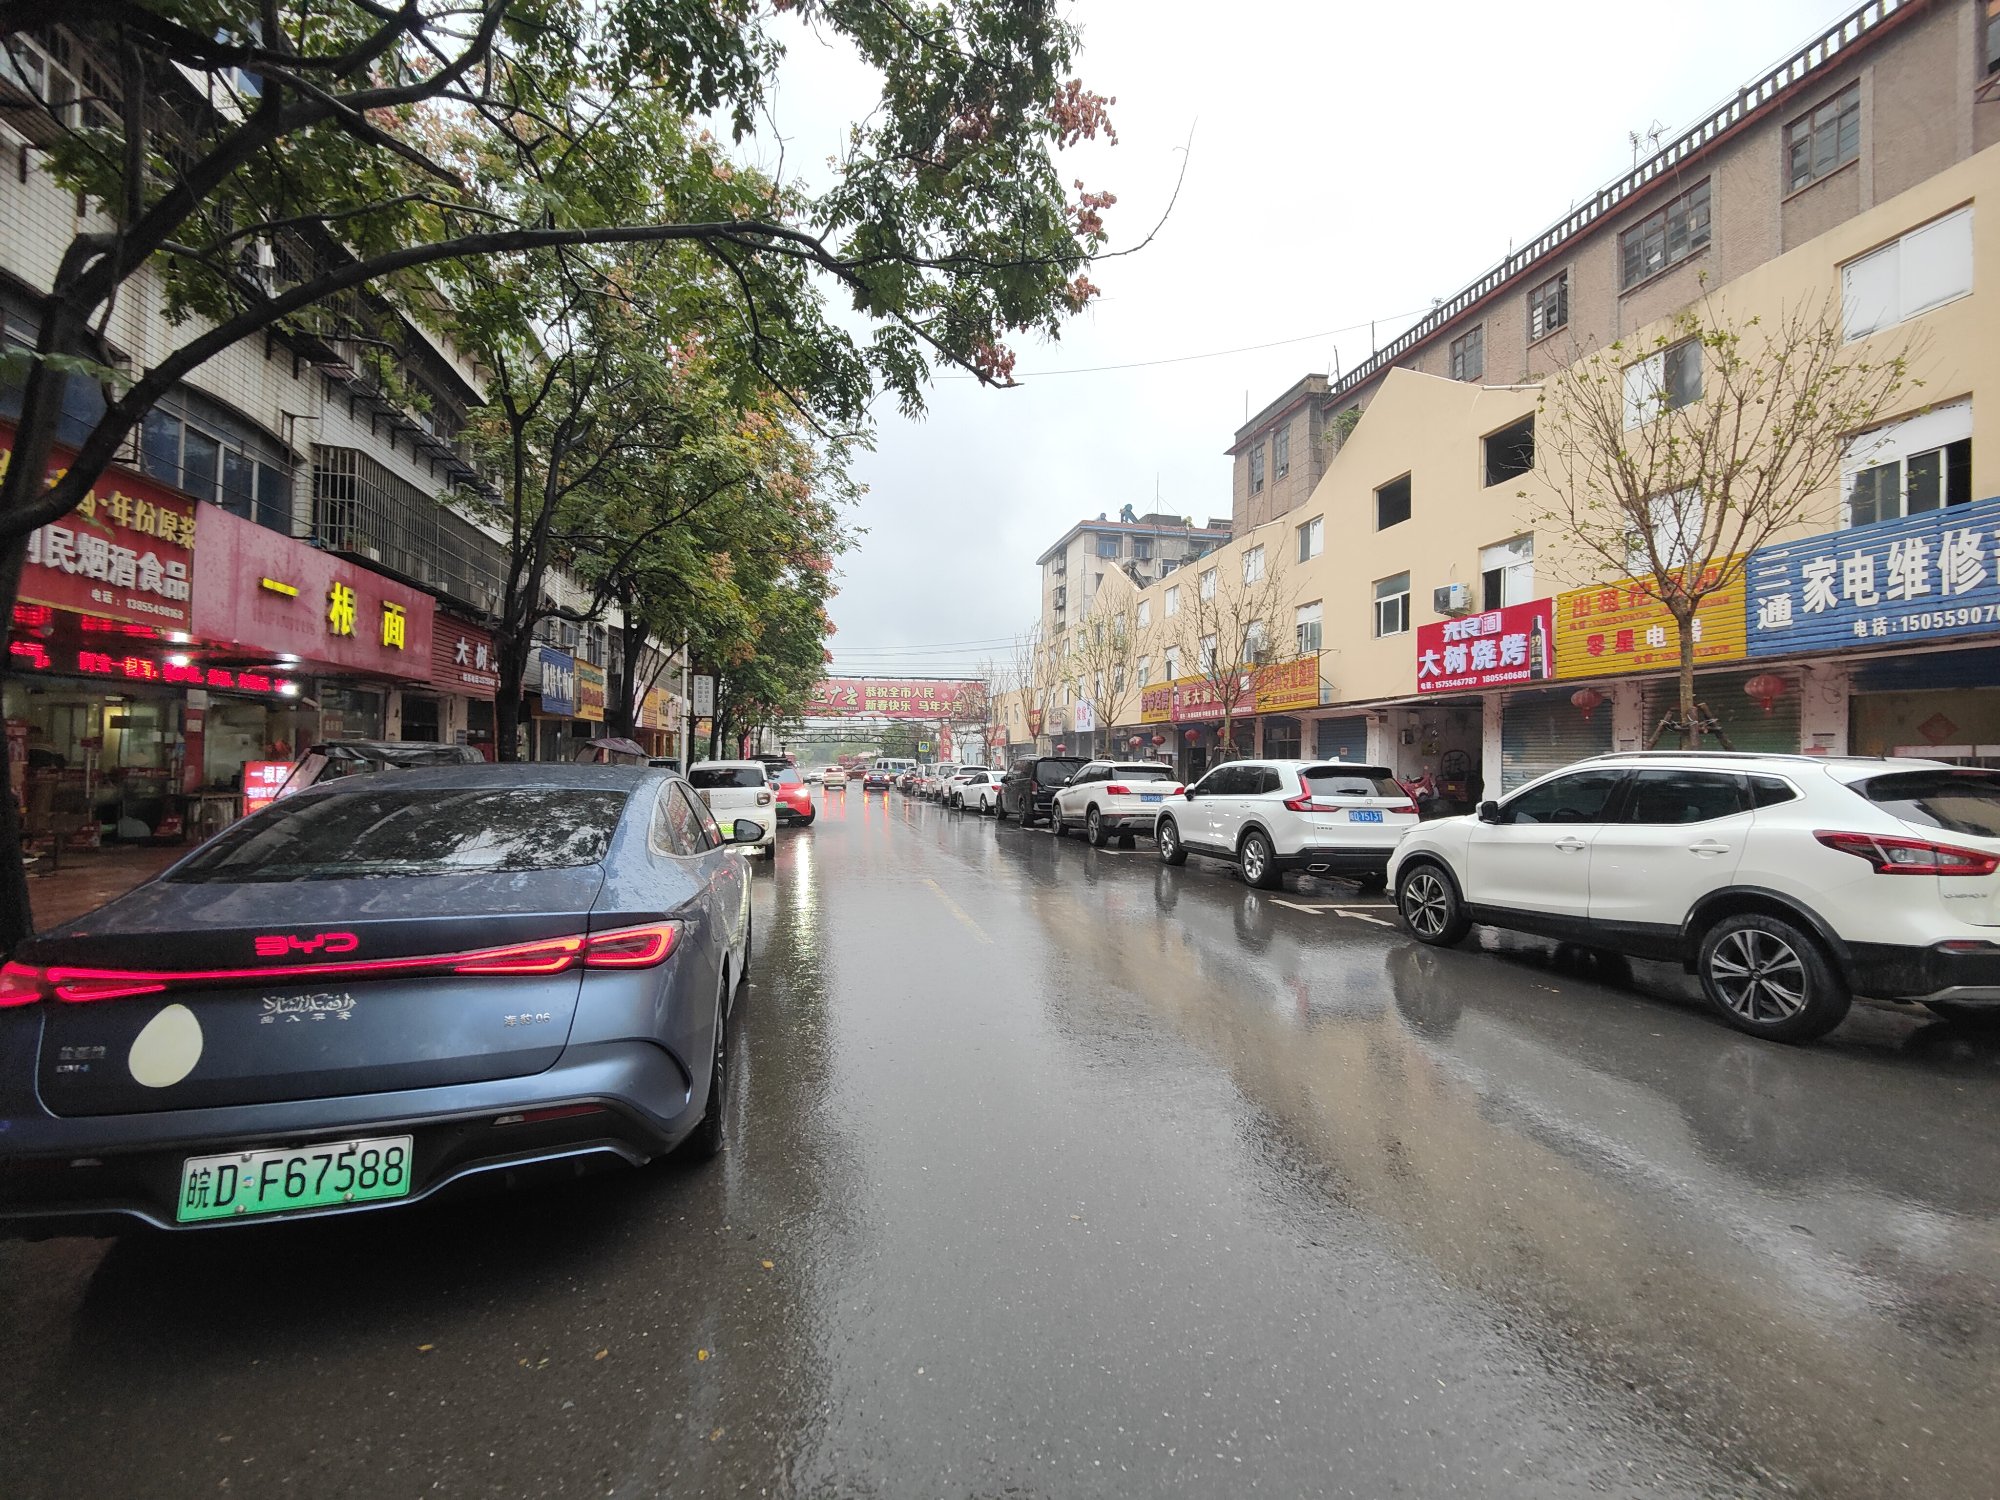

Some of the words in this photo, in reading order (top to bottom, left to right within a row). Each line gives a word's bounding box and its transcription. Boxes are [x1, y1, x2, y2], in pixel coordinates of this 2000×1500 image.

[28, 523, 190, 602] 民烟酒食品
[1802, 528, 2000, 614] 家电维修
[260, 577, 407, 650] 一根面
[1418, 634, 1528, 678] 大树烧烤
[865, 686, 935, 699] 恭祝全市人民
[865, 700, 912, 712] 新春快乐
[918, 700, 964, 712] 马年大吉
[255, 932, 359, 955] BYD
